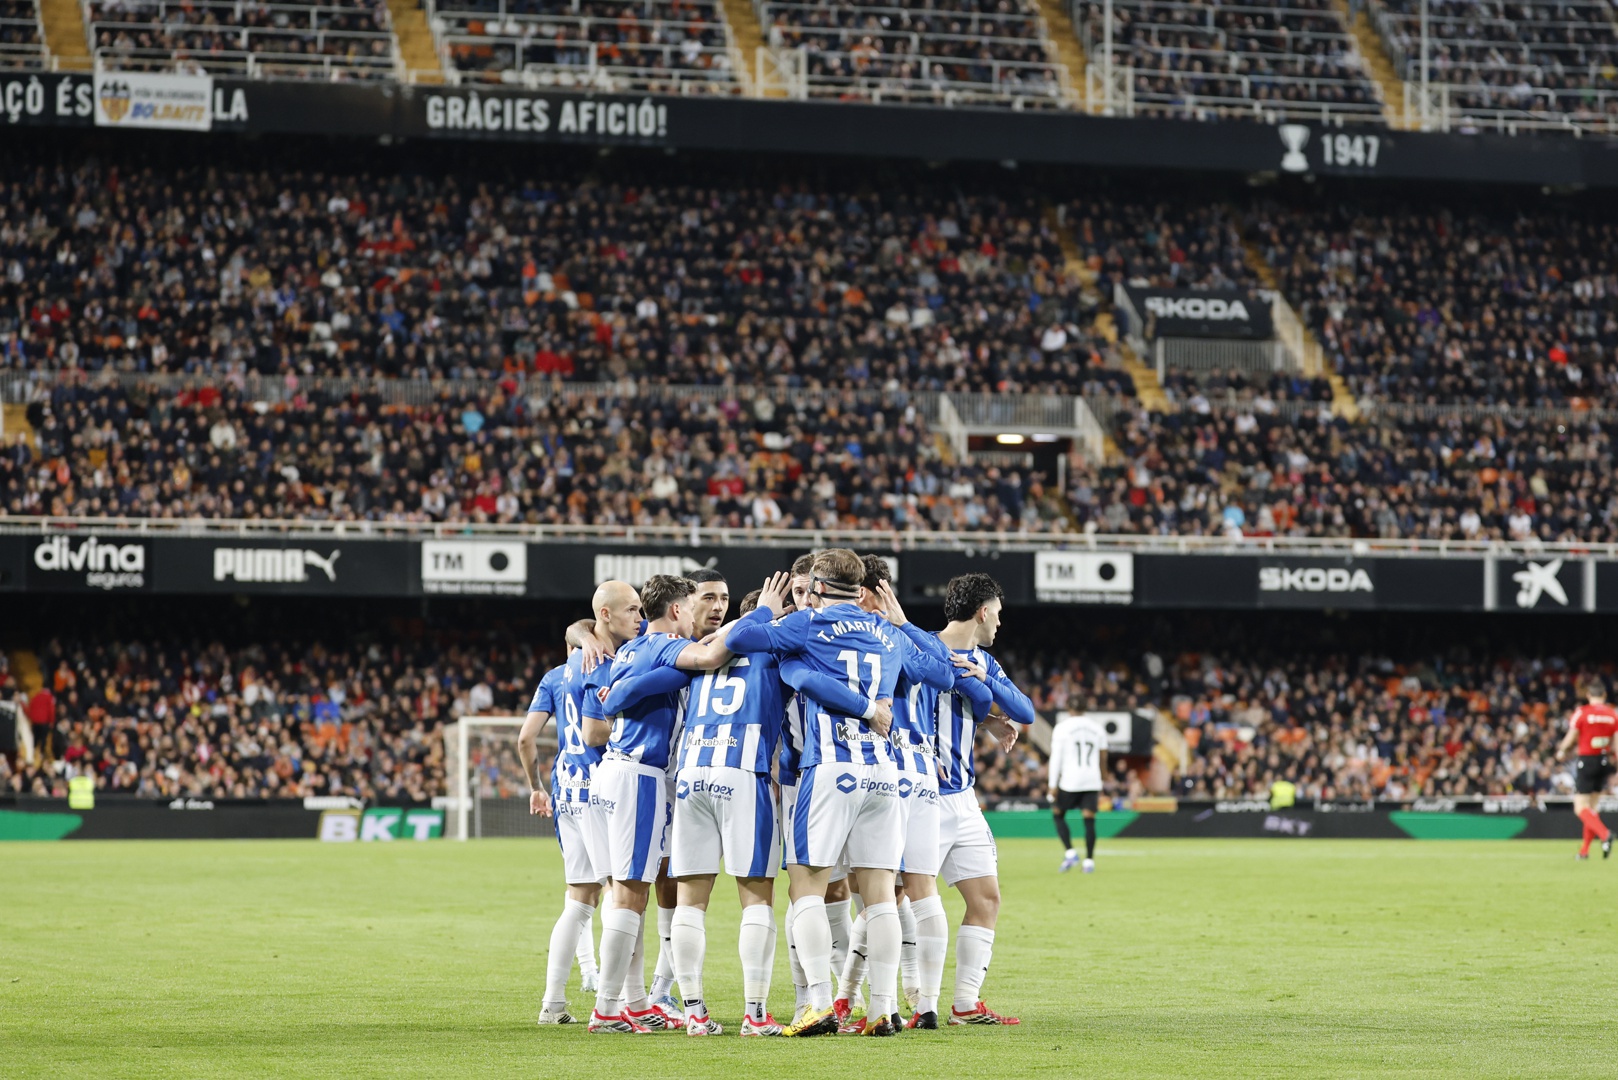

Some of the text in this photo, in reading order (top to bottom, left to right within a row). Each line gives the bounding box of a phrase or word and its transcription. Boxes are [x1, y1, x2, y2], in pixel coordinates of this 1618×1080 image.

[0, 75, 44, 123] ÇÒ
[56, 76, 93, 117] ÉS
[426, 91, 667, 137] GRÀCIES AFICIÓ!
[1320, 133, 1380, 168] 1947
[34, 535, 145, 572] divina
[213, 547, 304, 582] PUMA
[431, 552, 464, 571] TM
[86, 572, 145, 591] seguros
[1045, 563, 1074, 580] TM
[697, 657, 750, 718] 15
[836, 650, 882, 701] 11
[564, 693, 586, 755] 8
[684, 732, 738, 751] Kutxabank
[1074, 741, 1095, 768] 17
[319, 814, 443, 842] BKT
